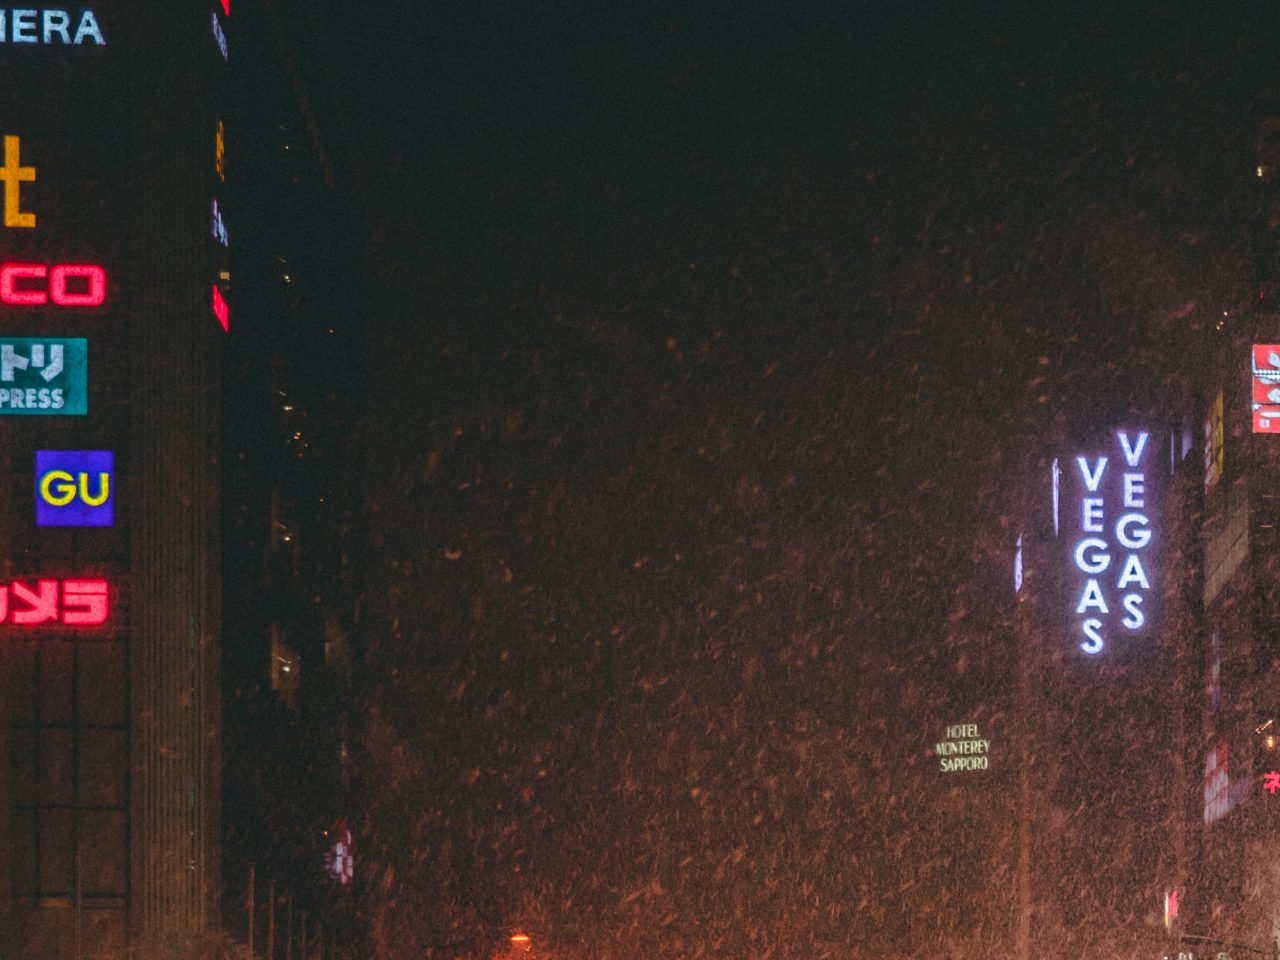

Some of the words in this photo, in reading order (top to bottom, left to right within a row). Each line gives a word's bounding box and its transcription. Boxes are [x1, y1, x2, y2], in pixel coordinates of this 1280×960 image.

[0, 262, 107, 306] CO
[39, 469, 111, 507] GU
[1115, 432, 1152, 630] VEGAS
[1074, 456, 1111, 655] VEGAS
[936, 739, 991, 756] MONTEREY
[947, 723, 980, 739] HOTEL
[940, 756, 988, 773] SAPPORO
